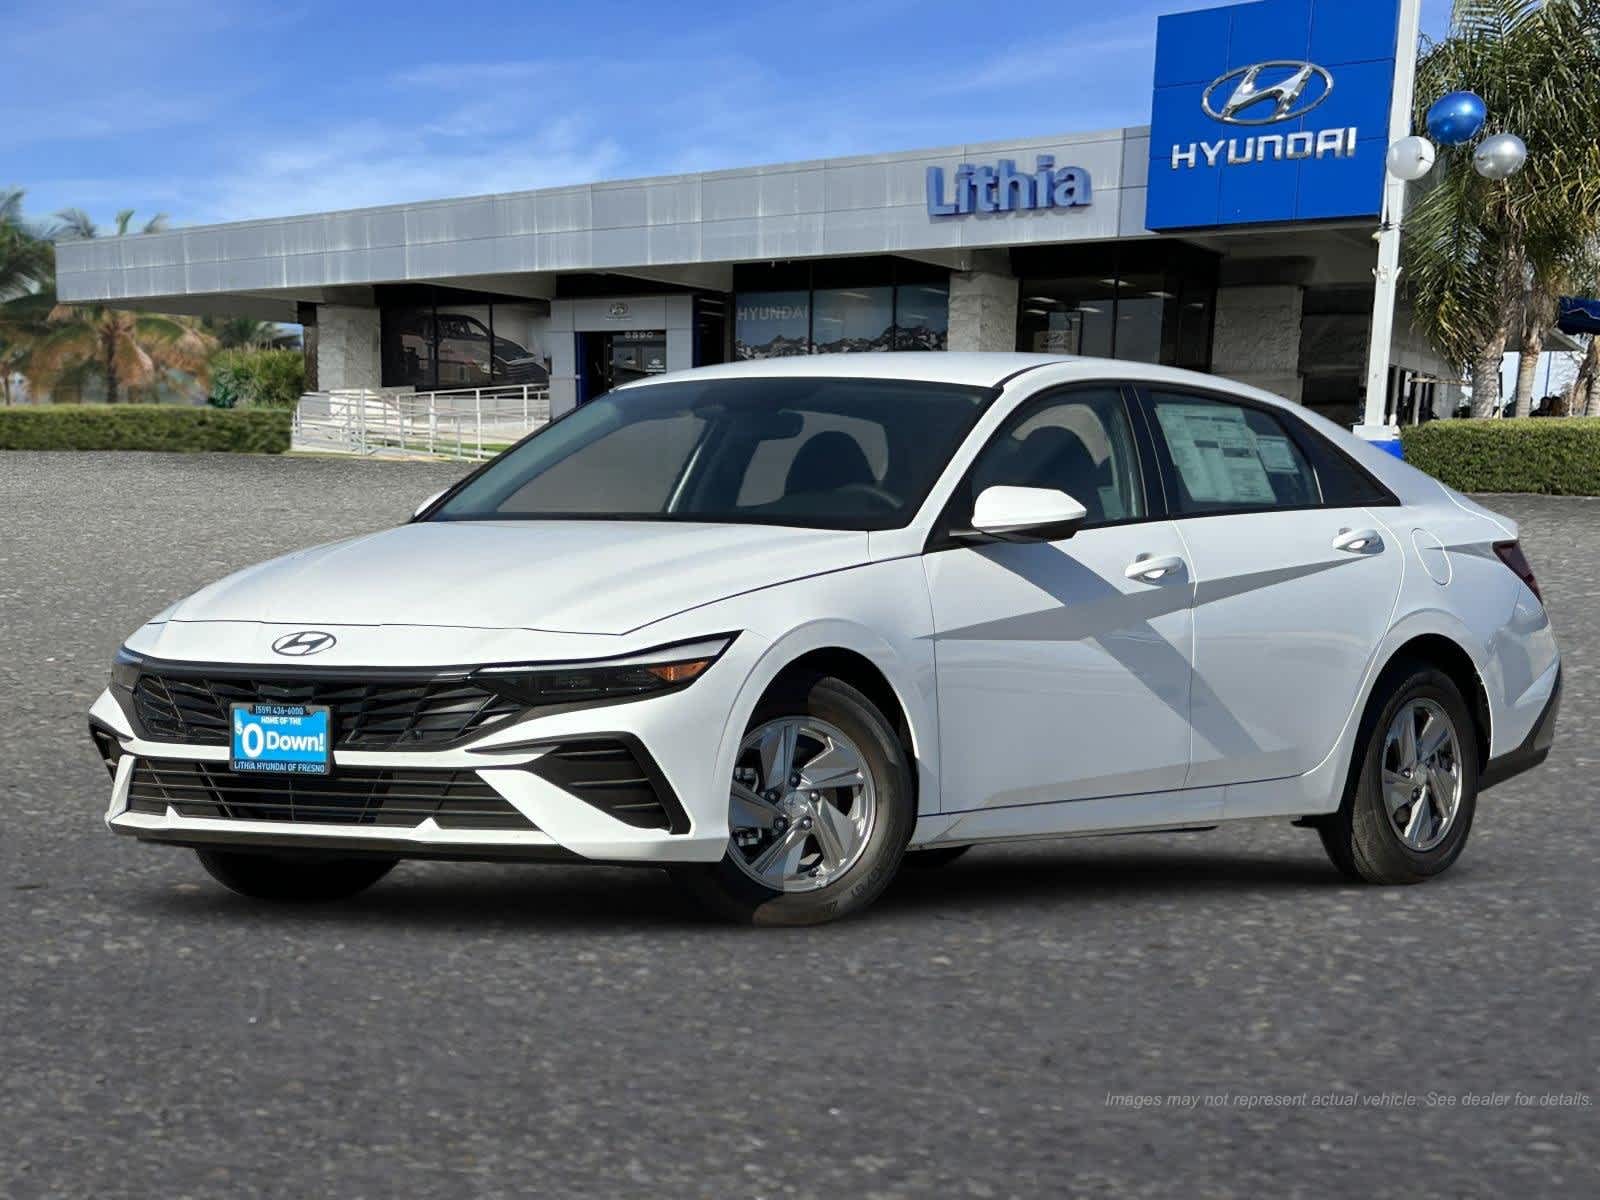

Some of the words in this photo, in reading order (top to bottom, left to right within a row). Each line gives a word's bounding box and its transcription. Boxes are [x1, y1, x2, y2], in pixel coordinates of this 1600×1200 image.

[1171, 127, 1357, 169] HYUNDAI
[926, 155, 1092, 215] Lithia
[737, 304, 808, 321] HYUNDAI
[261, 716, 279, 725] HOME
[280, 717, 289, 725] OF
[289, 717, 302, 726] THE
[266, 731, 325, 752] Down!
[234, 761, 256, 770] LITHIA
[256, 762, 287, 772] HYUNDAI
[288, 763, 297, 772] OF
[298, 764, 325, 773] FRESNO
